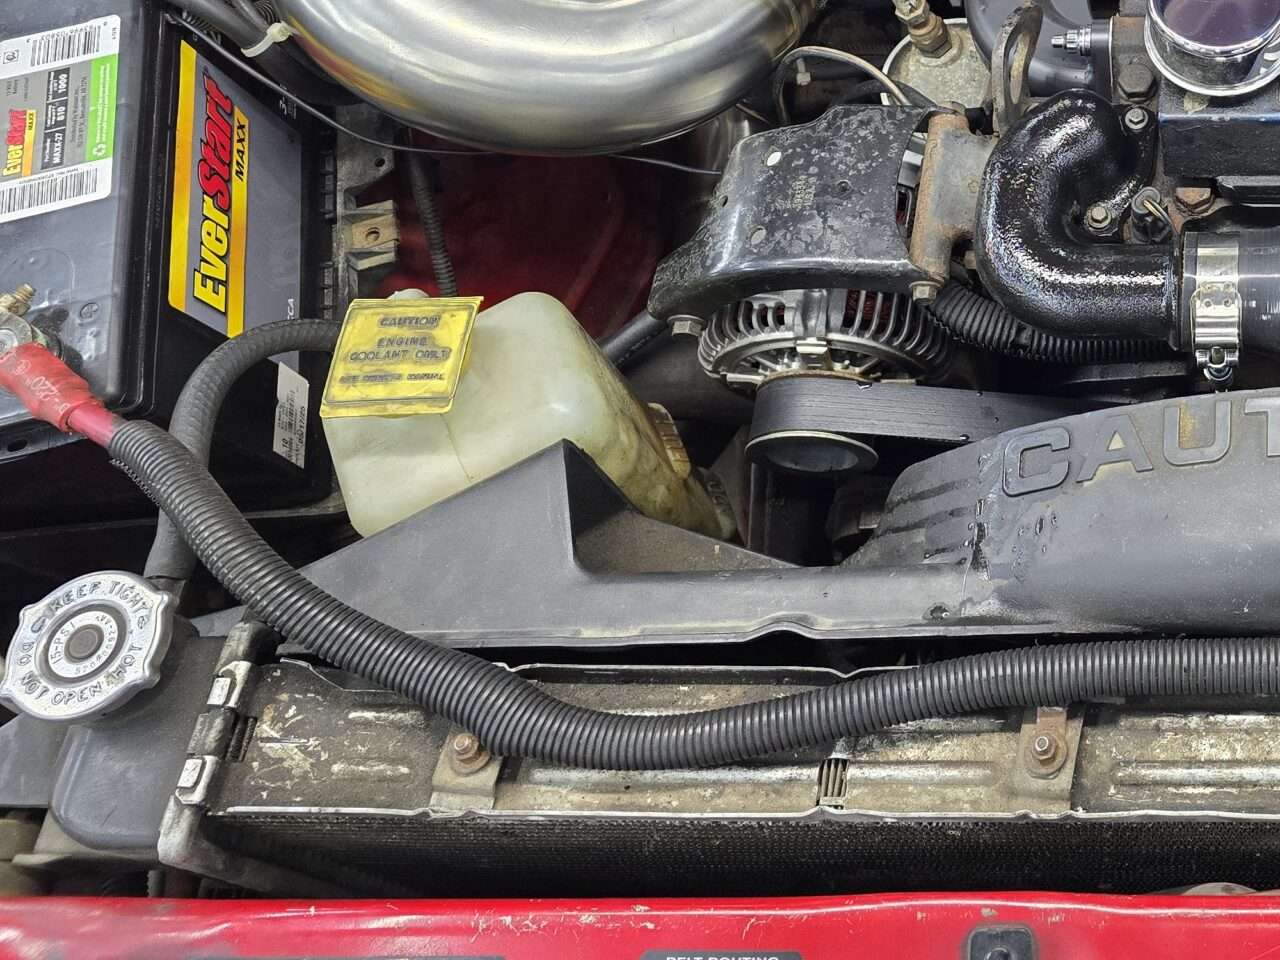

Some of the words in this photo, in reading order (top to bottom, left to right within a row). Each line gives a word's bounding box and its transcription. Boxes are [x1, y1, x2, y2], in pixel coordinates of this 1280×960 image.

[234, 120, 249, 183] MAXX
[192, 73, 235, 314] EverStart
[380, 314, 440, 328] CAUTION
[350, 350, 410, 362] COOLANT
[377, 337, 430, 349] ENGINE
[48, 581, 102, 613] KEEP
[107, 580, 149, 613] TIGHT
[17, 641, 35, 666] DO
[108, 643, 143, 681] HOT
[21, 670, 50, 700] NOT
[50, 681, 103, 706] OPEN
